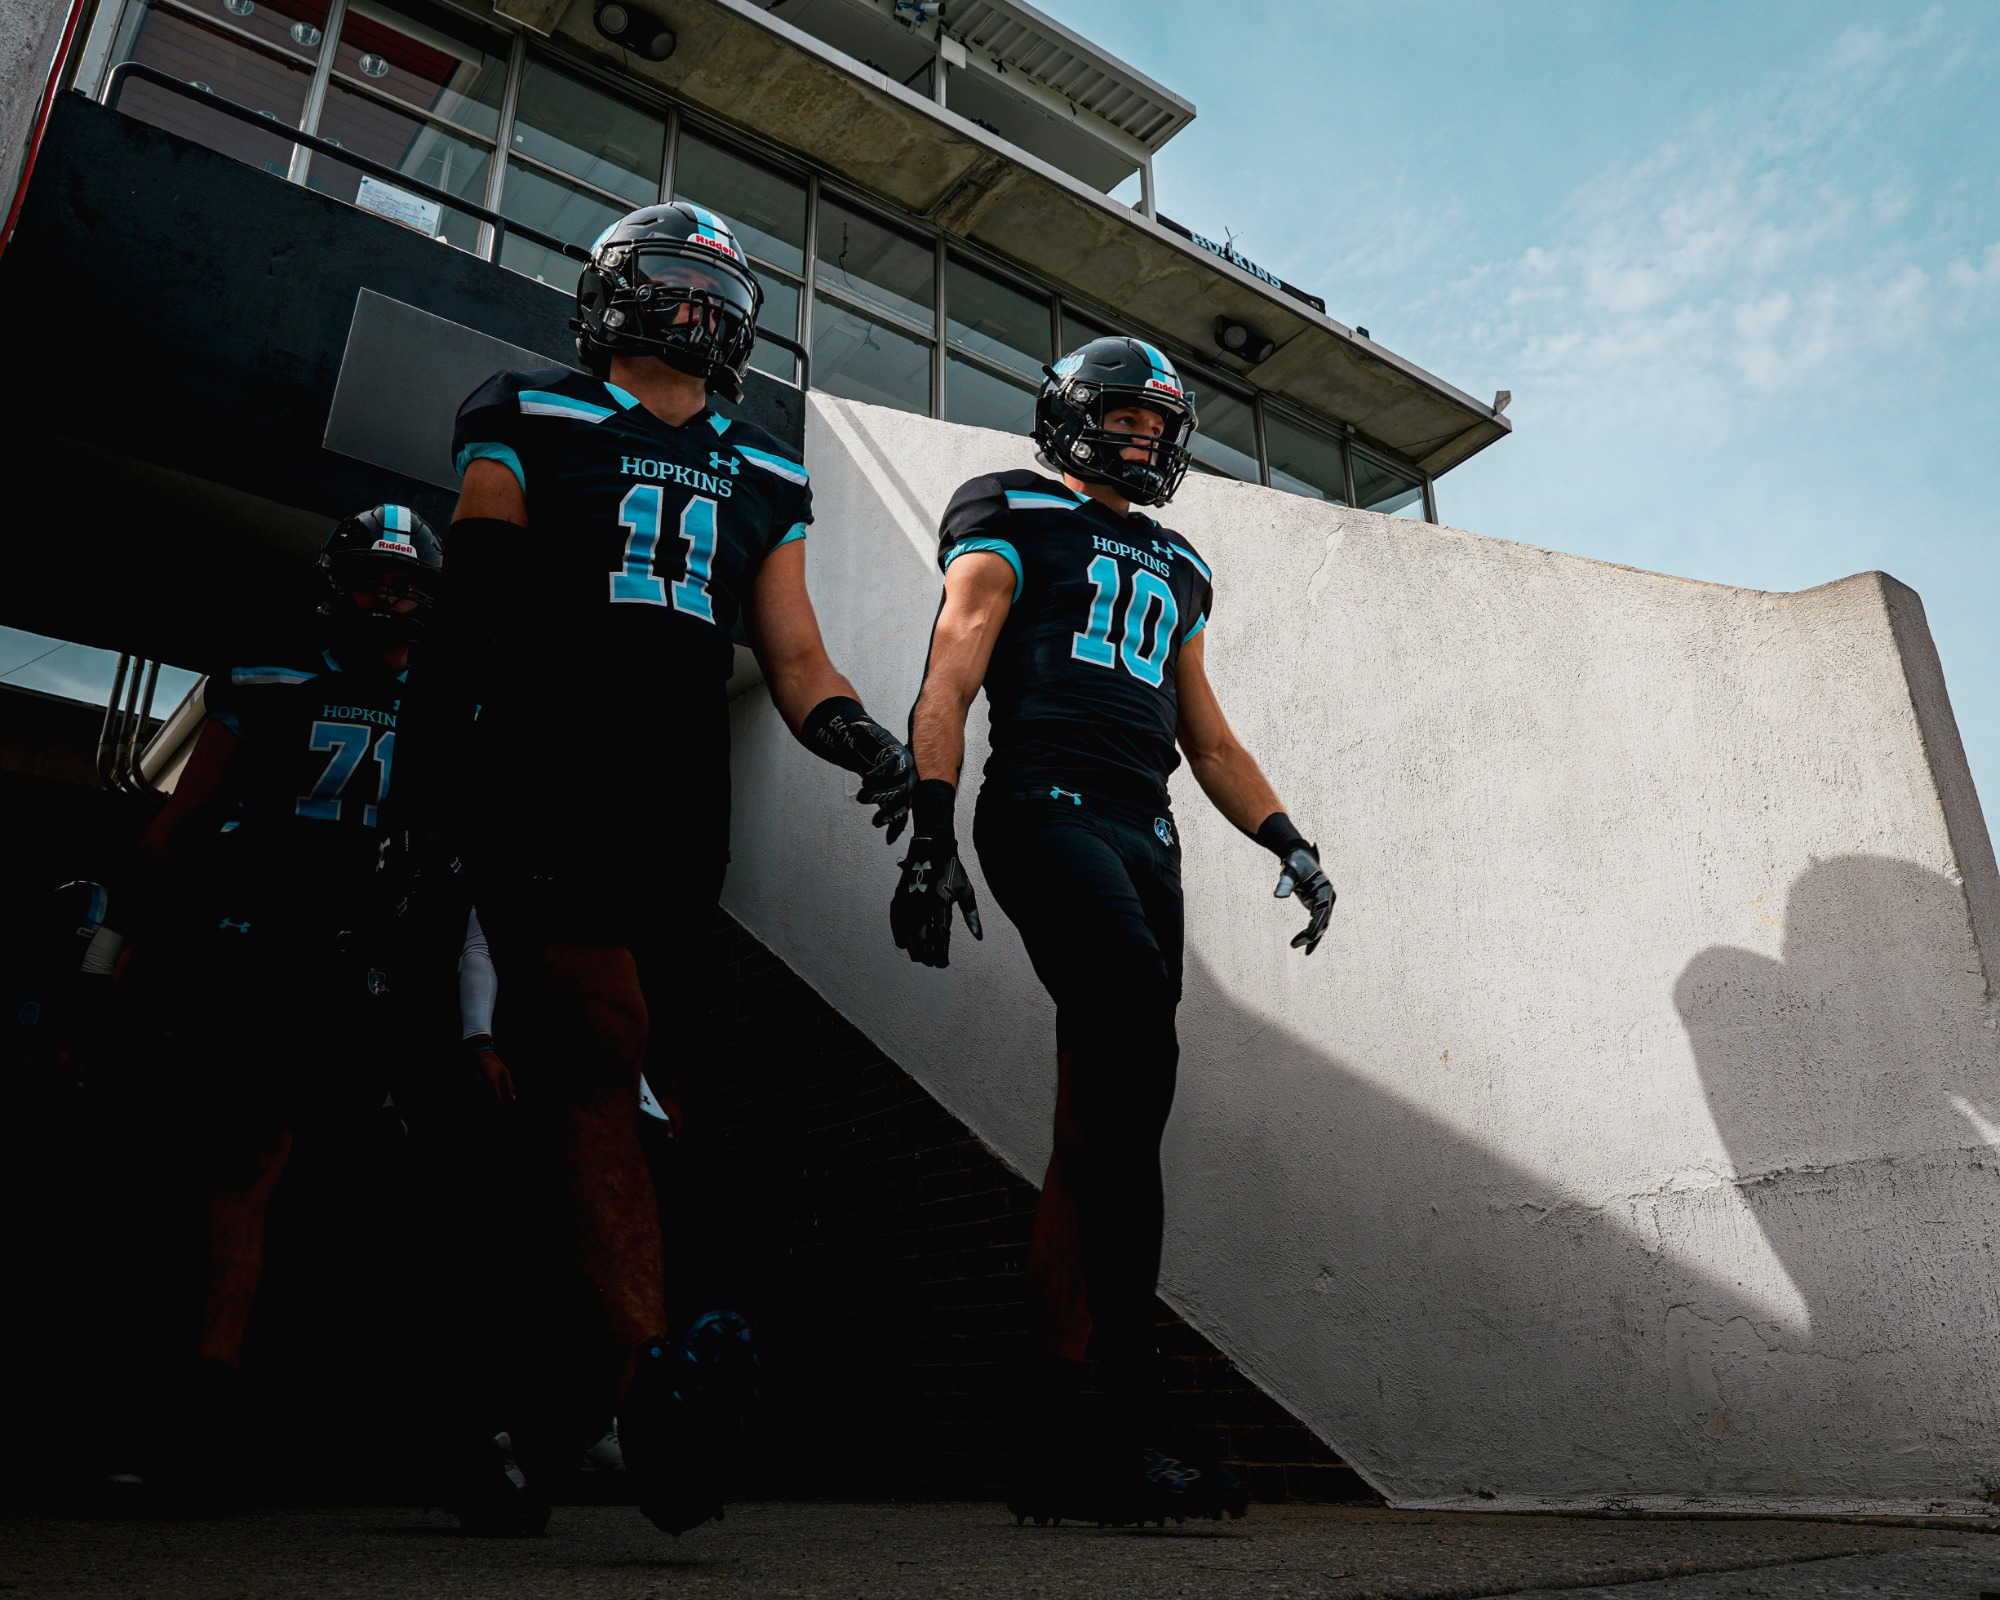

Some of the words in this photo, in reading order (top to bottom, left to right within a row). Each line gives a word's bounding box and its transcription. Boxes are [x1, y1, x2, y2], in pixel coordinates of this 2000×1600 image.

[696, 235, 735, 257] Riddell
[620, 456, 733, 498] HOPKINS
[378, 541, 412, 553] Riddell
[609, 483, 718, 625] 11
[1092, 535, 1170, 578] HOPKINS
[1071, 554, 1179, 688] 10
[322, 704, 398, 728] HOPKIN
[295, 720, 396, 828] 71
